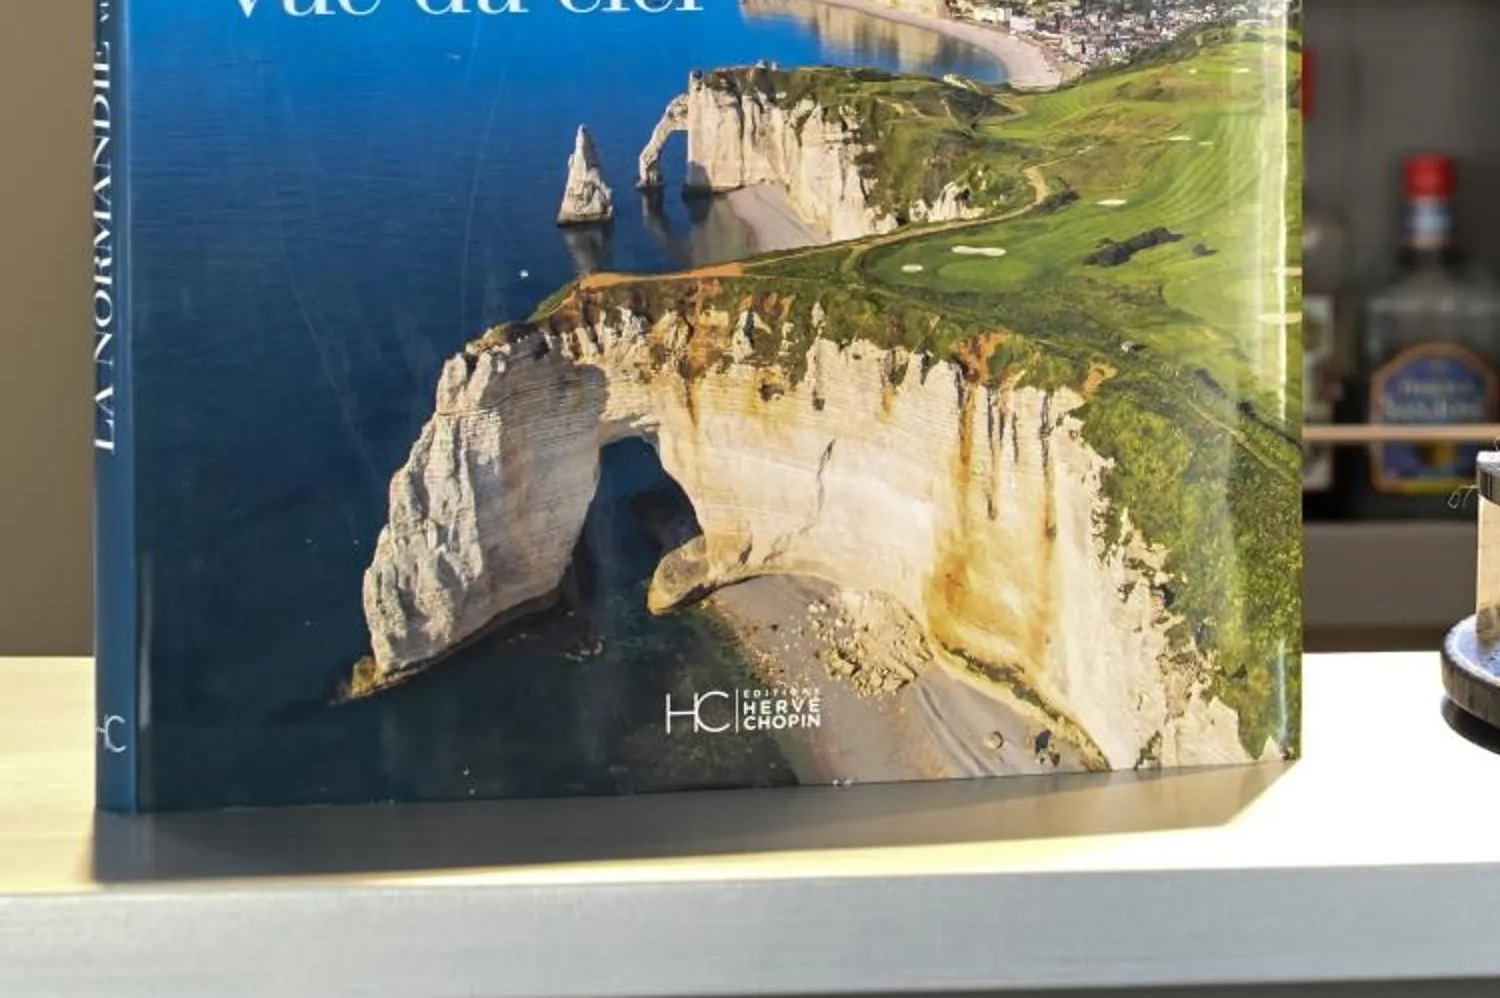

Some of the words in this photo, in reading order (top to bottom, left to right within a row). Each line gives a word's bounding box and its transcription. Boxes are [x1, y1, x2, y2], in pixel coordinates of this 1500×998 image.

[92, 40, 113, 369] NORMANDIE
[93, 385, 115, 454] LA
[665, 689, 732, 734] HC
[743, 713, 822, 731] CHOPIN
